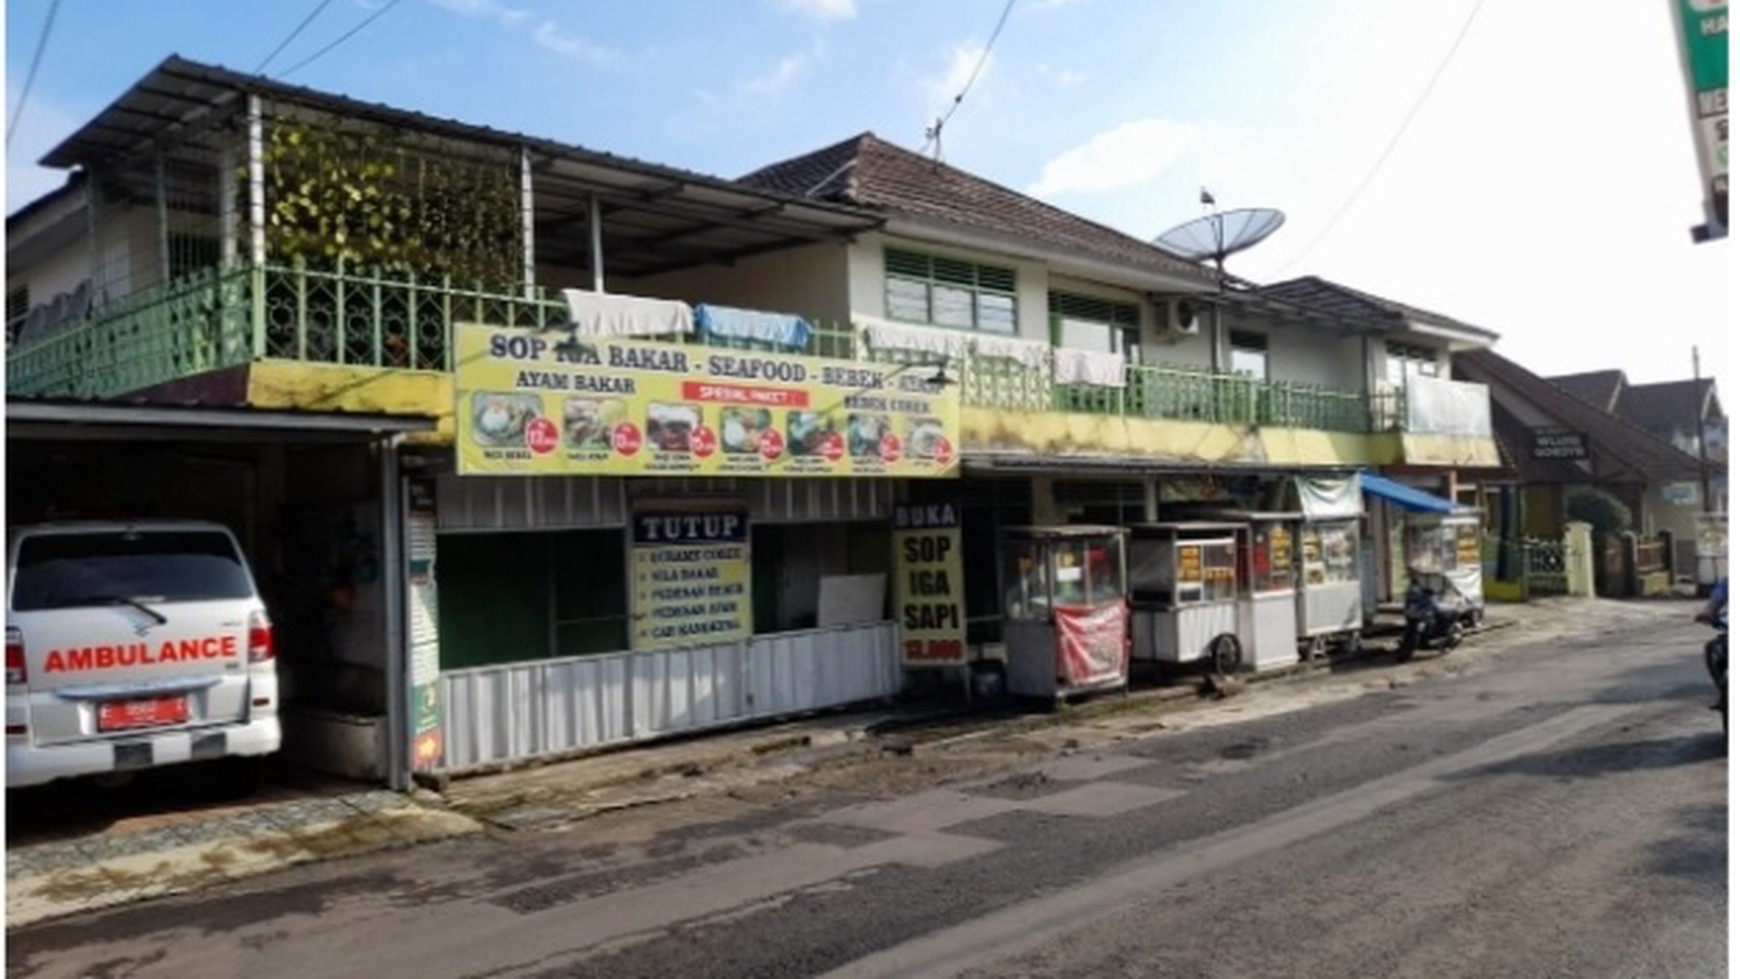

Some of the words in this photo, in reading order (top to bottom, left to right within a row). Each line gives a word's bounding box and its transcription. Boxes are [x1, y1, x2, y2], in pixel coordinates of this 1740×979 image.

[489, 335, 547, 360] SOP
[608, 345, 689, 373] BAKAR
[709, 355, 807, 382] SEAFOOD
[822, 366, 885, 390] BEBEK
[516, 371, 568, 390] AYAM
[574, 374, 635, 394] BAKAR
[642, 515, 738, 539] TUTUP
[896, 504, 955, 526] BUKA
[904, 536, 951, 563] SOP
[909, 570, 951, 597] IGA
[904, 604, 959, 630] SAPI
[44, 636, 236, 673] AMBULANCE
